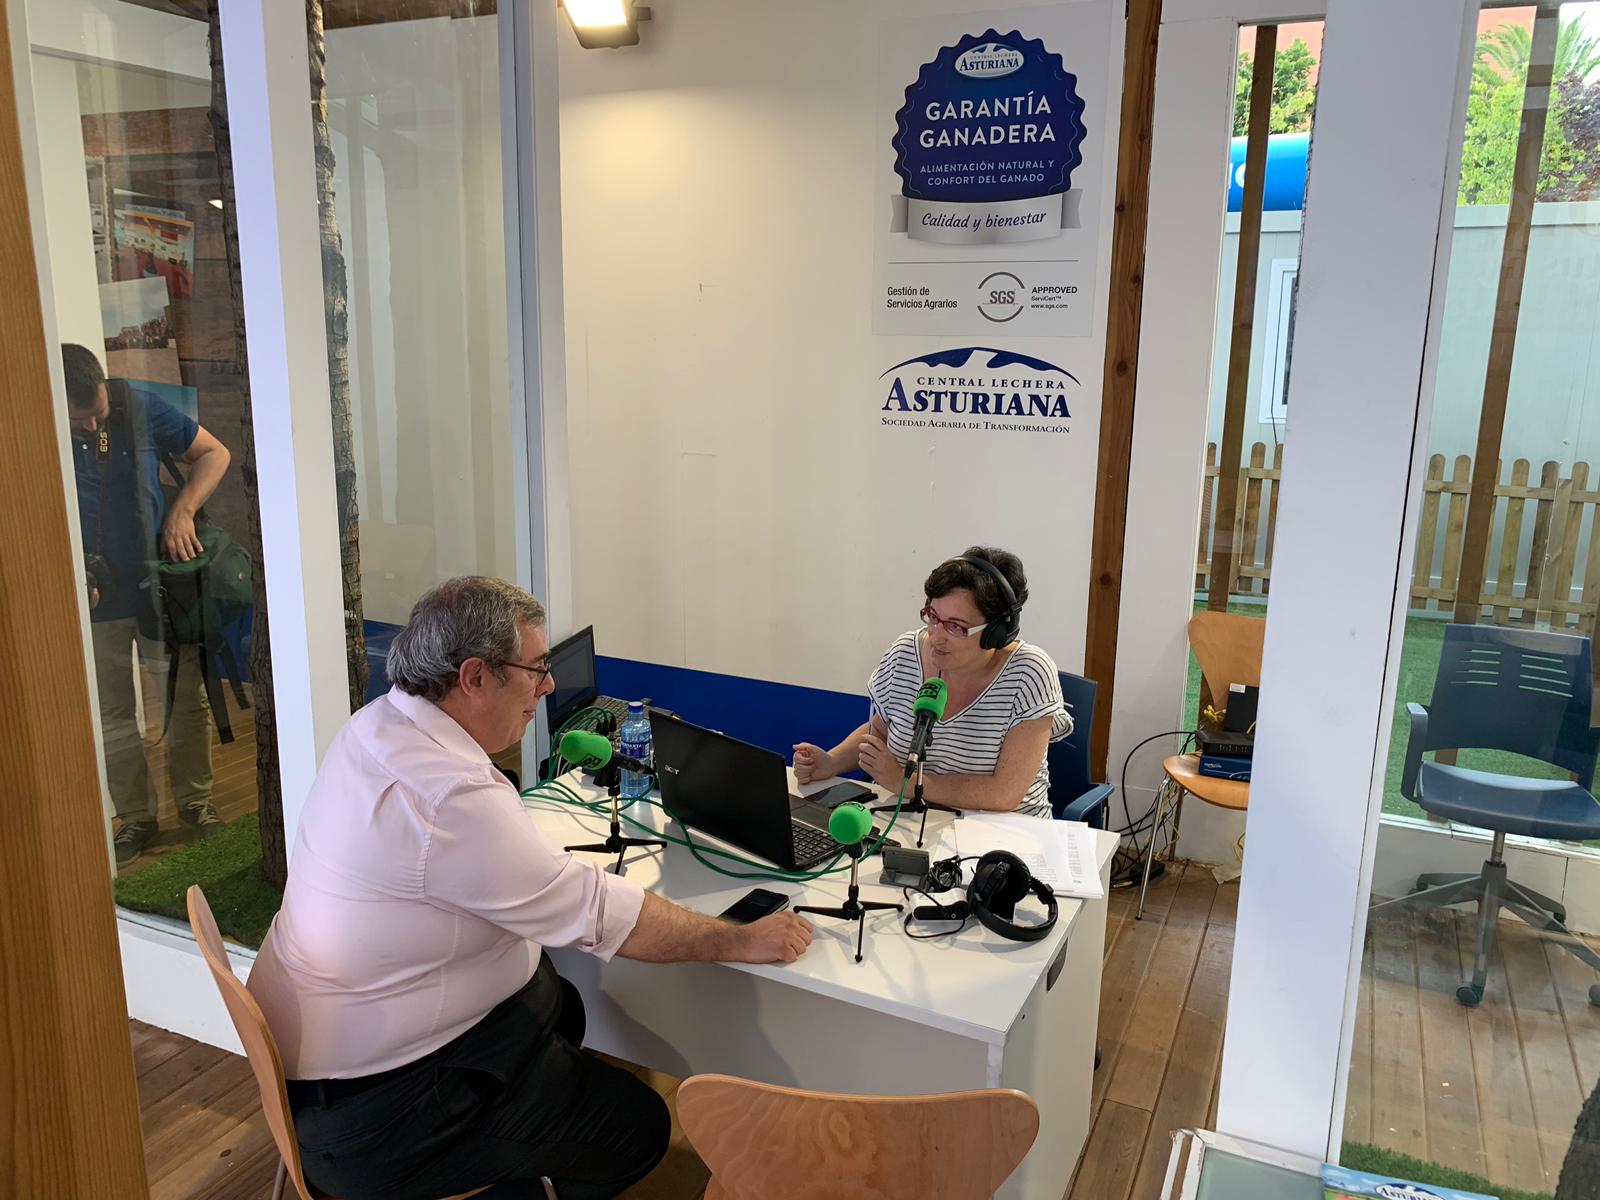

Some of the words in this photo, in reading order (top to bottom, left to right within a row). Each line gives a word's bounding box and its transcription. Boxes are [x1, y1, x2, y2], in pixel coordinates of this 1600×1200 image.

[959, 56, 1019, 71] ASTURIANA
[925, 90, 1052, 121] GARANTÍA
[919, 123, 1056, 149] GANADERA
[920, 160, 995, 173] ALIMENTACIÓN
[998, 160, 1045, 171] NATURAL
[1048, 159, 1055, 168] Y
[927, 176, 975, 186] CONFORT
[978, 175, 997, 184] DEL
[1000, 173, 1045, 183] GANADO
[921, 212, 971, 228] Calidad
[972, 218, 982, 232] y
[985, 212, 1047, 228] bienestar
[887, 286, 918, 296] Gestión
[919, 286, 930, 296] de
[989, 290, 1015, 305] SGS
[1031, 286, 1078, 294] APPROVED
[887, 298, 923, 309] Servicios
[923, 298, 958, 310] Agrarios
[916, 376, 985, 388] CENTRAL
[991, 378, 1065, 390] LECHERA
[881, 377, 1072, 418] ASTURIANA
[881, 417, 926, 427] SOCIEDAD
[927, 419, 967, 429] AGRARIA
[969, 421, 982, 430] DE
[983, 421, 1070, 433] TRANSFORMACIÓN
[99, 431, 108, 453] EOS
